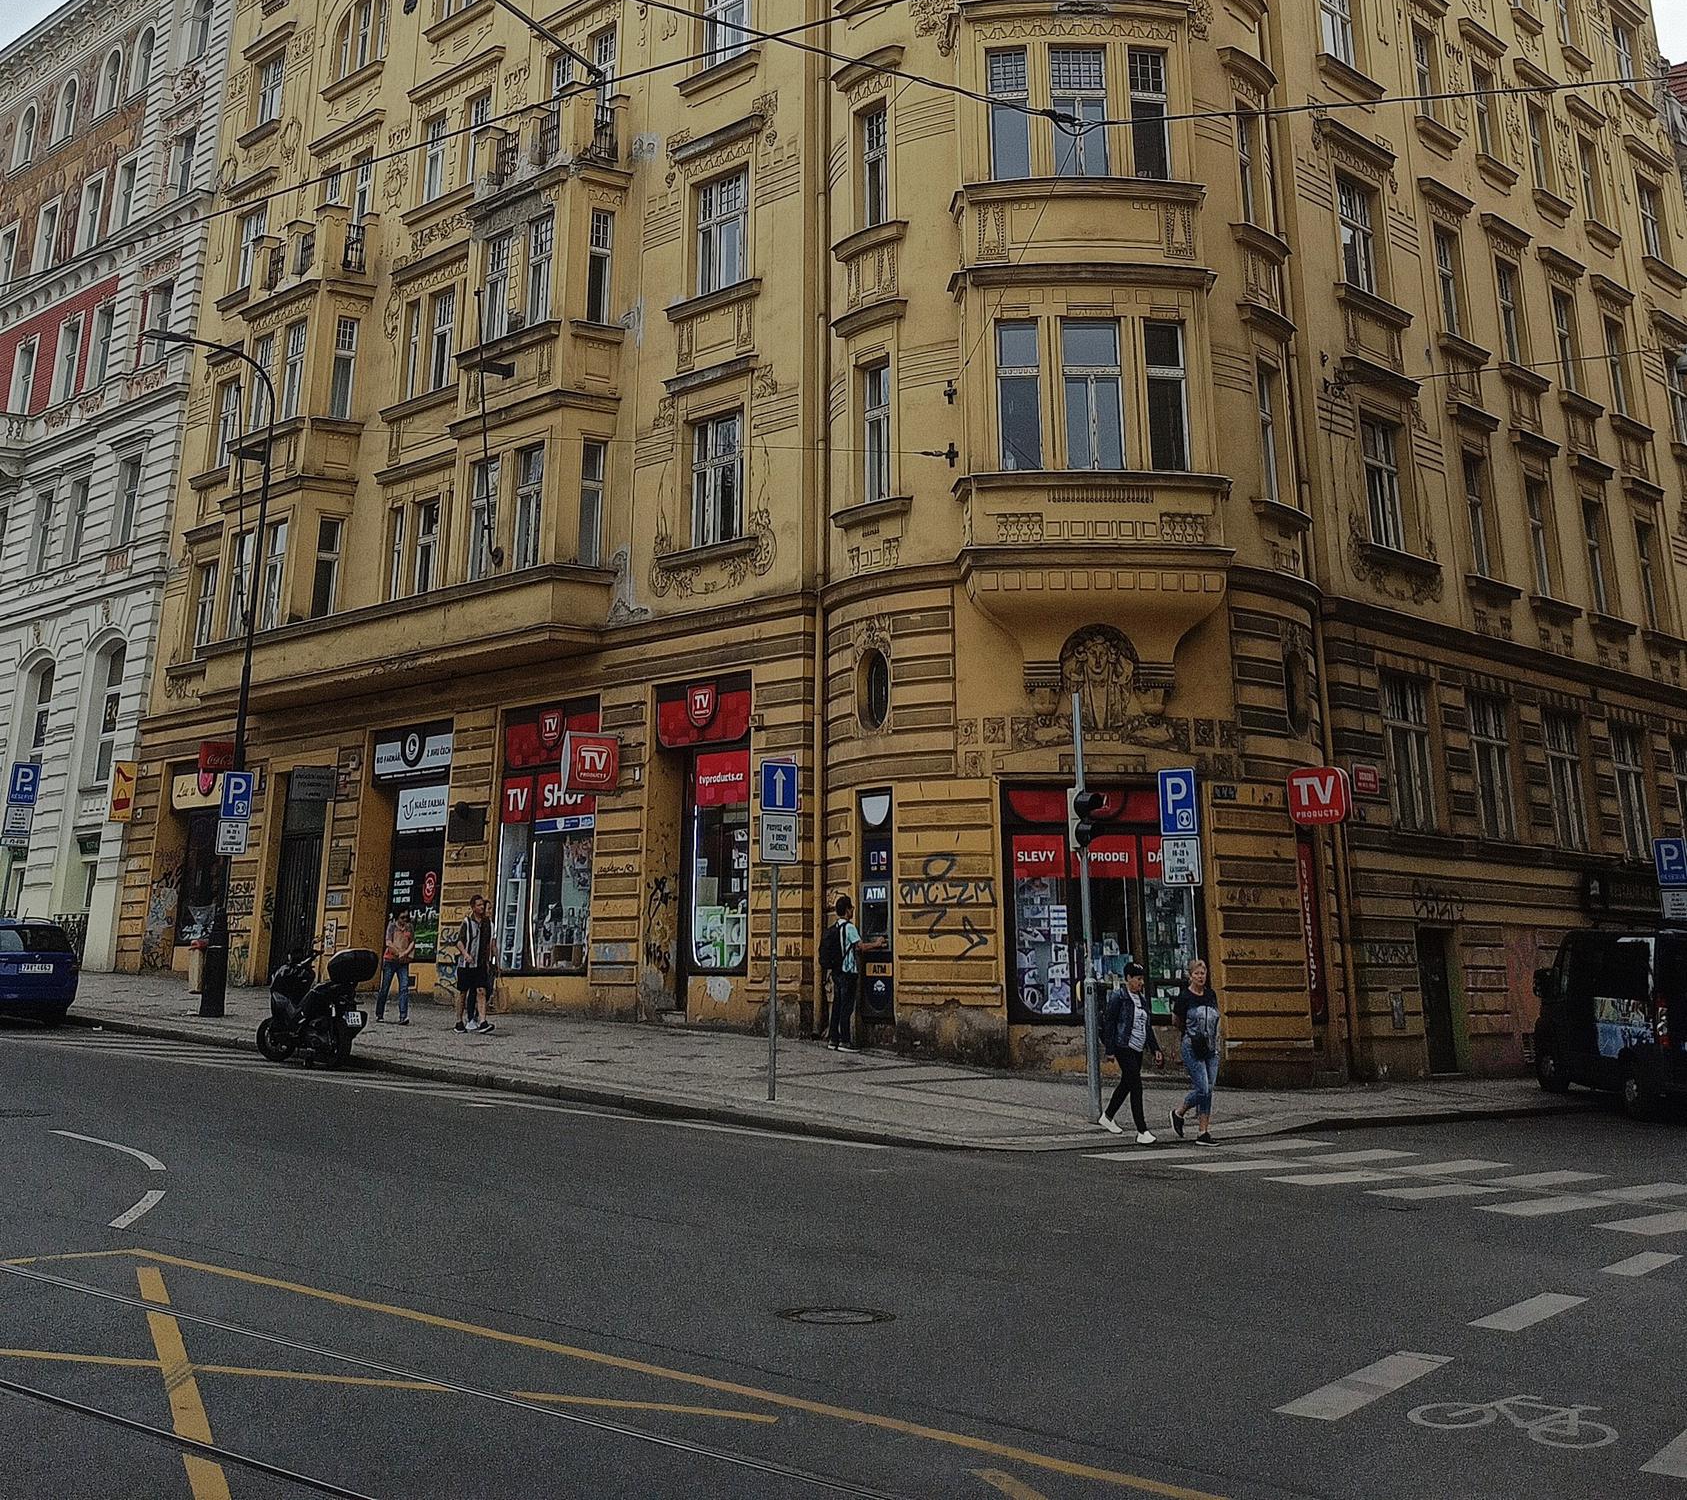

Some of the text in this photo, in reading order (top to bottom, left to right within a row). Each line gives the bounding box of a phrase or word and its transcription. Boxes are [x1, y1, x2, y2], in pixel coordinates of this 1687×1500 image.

[695, 694, 710, 710] TV
[544, 718, 558, 732] TV
[580, 749, 609, 771] TV
[16, 767, 34, 792] P
[228, 777, 247, 804] P
[699, 772, 744, 787] tvproducts.cz
[1292, 775, 1335, 806] TV
[507, 787, 528, 812] TV
[1166, 777, 1187, 815] P
[1296, 809, 1340, 819] PRODUCTS
[1017, 850, 1056, 863] SLEVY
[1659, 843, 1679, 871] P
[865, 887, 886, 900] ATM
[1300, 859, 1318, 991] tvproducts.cz
[872, 964, 887, 975] ATM
